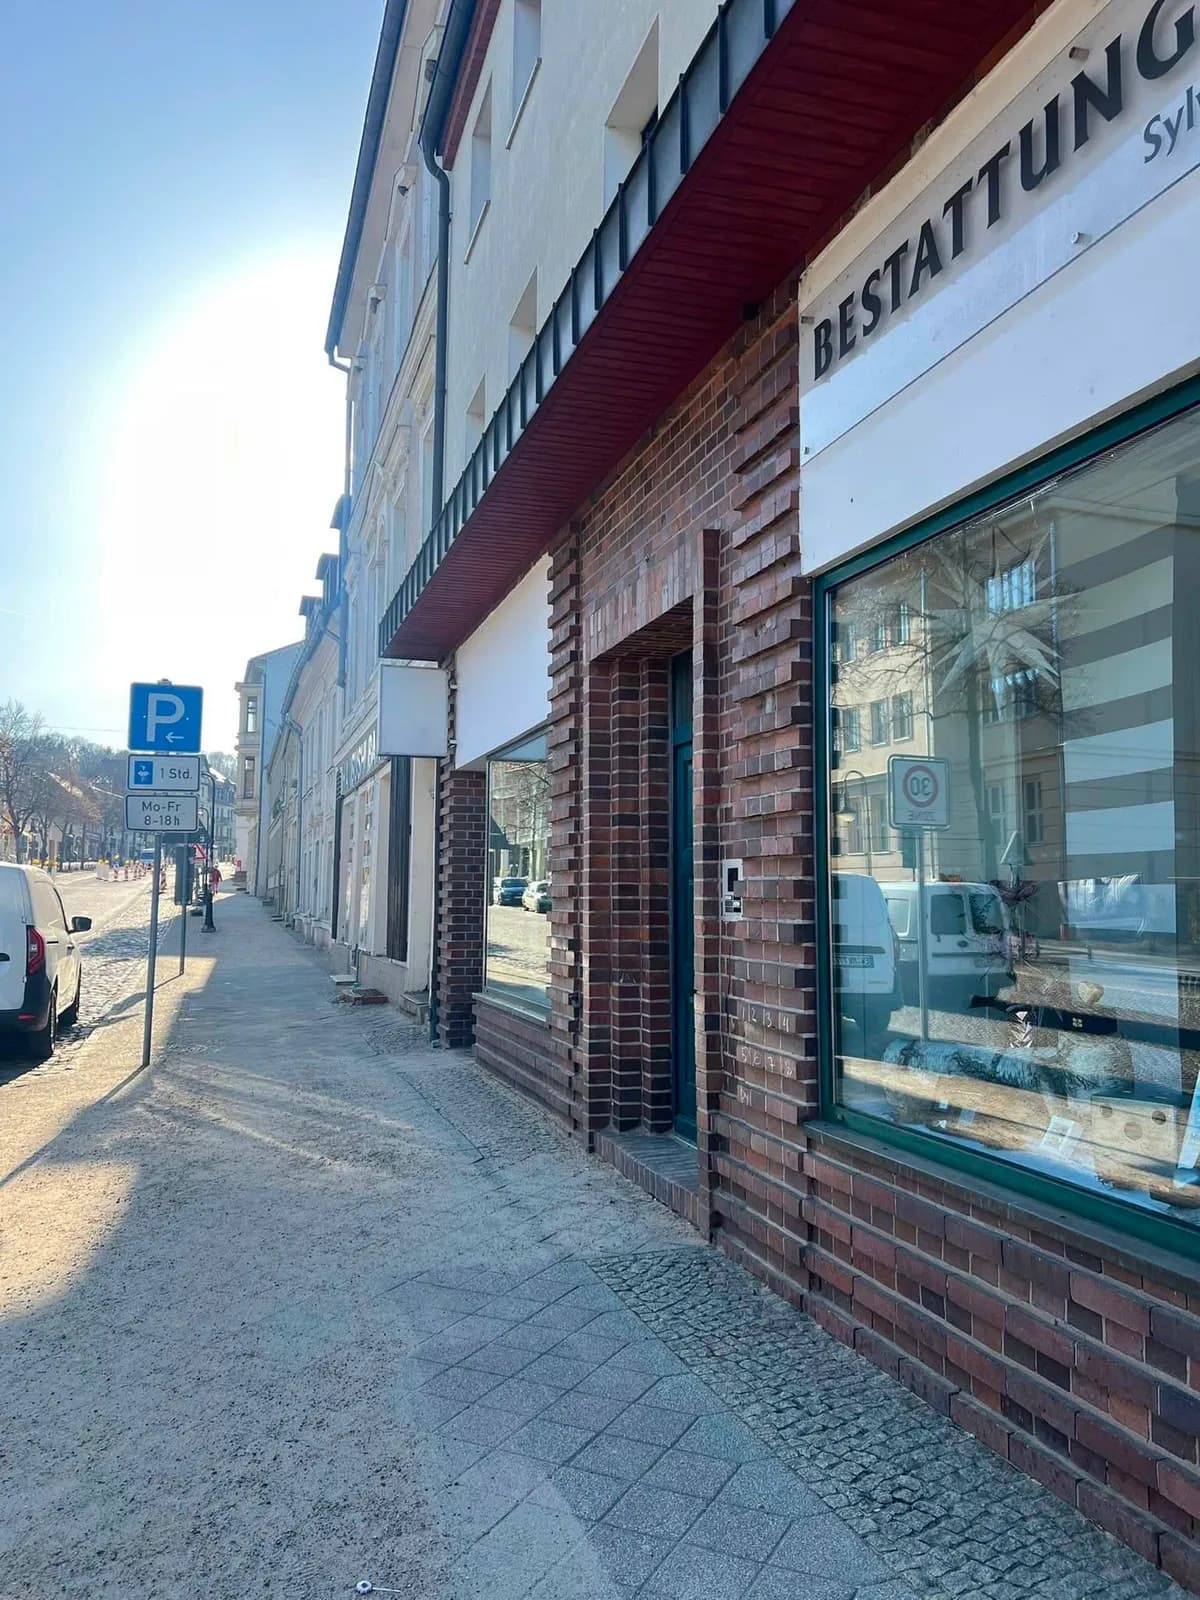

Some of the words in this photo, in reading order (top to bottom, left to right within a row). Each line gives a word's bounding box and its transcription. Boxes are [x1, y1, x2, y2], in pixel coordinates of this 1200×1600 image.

[1143, 85, 1200, 164] Syl
[146, 692, 185, 742] P
[160, 767, 164, 779] 1
[168, 768, 192, 780] Std.
[142, 801, 181, 812] Mo-Fr
